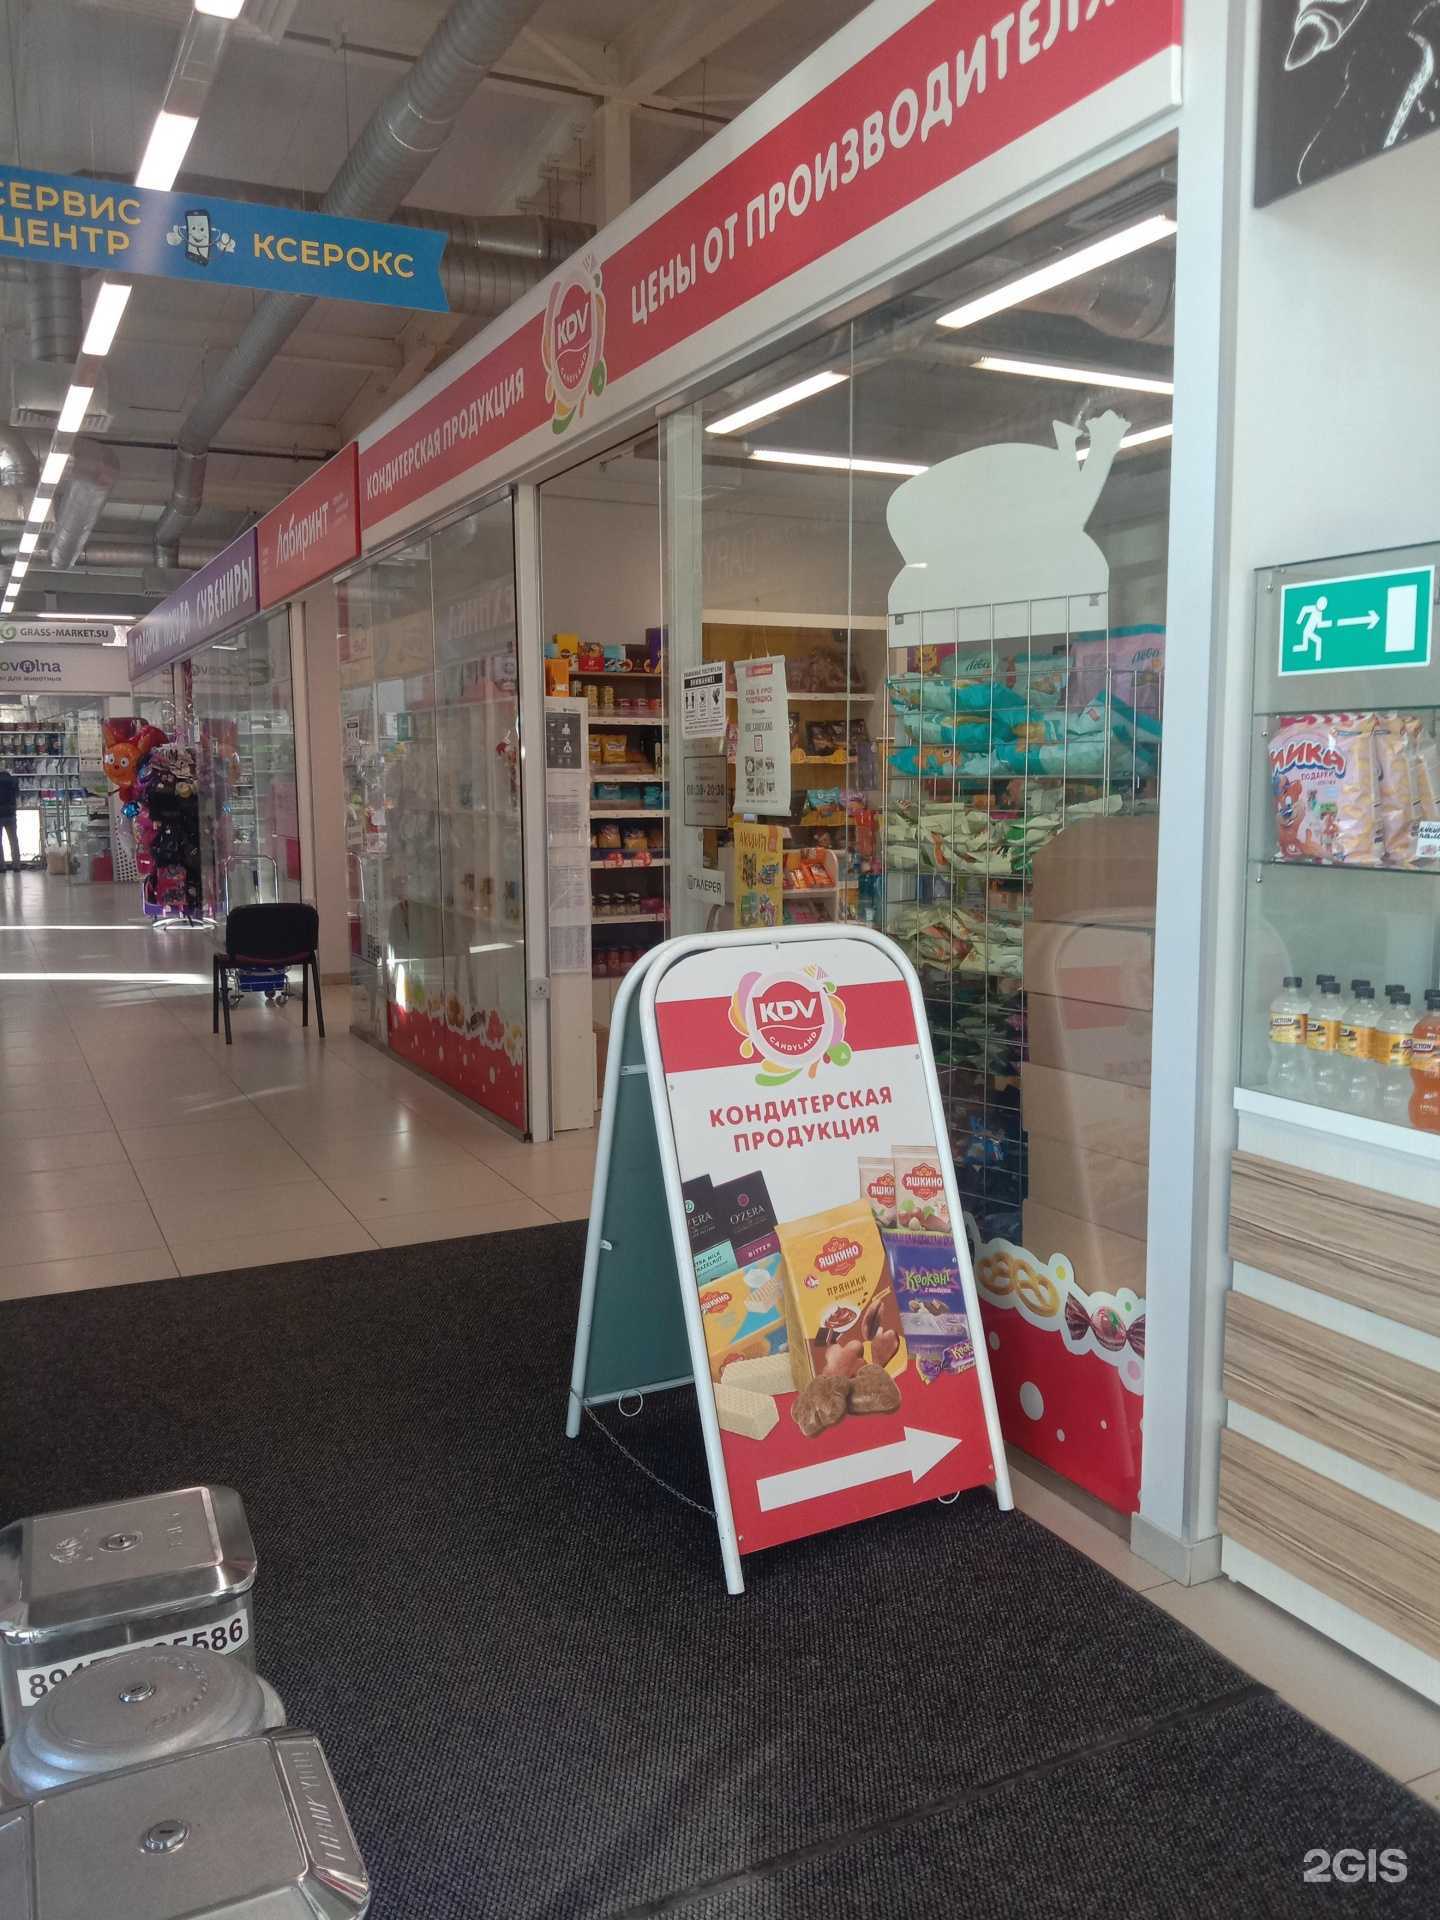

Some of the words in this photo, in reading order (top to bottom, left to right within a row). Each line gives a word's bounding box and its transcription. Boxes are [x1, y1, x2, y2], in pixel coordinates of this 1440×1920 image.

[0, 180, 141, 225] ЕРВИС
[0, 214, 131, 255] ЦЕНТР
[253, 233, 415, 279] КСЕРОКС
[631, 243, 697, 325] ЦЕНЫ
[703, 212, 739, 275] ОТ
[556, 301, 590, 350] KDV
[365, 432, 442, 501] КОНДИТЕРСКАЯ
[442, 367, 525, 451] ПРОДУКЦИЯ
[196, 556, 254, 631] СУВЕНИРЫ
[19, 627, 109, 639] GRASS-MARKET.SU
[758, 997, 818, 1024] KDV
[769, 1031, 819, 1051] CANDYLAND
[709, 1086, 893, 1128] КОНДИТЕРСКАЯ
[733, 1114, 881, 1153] ПРОДУКЦИЯ
[871, 1186, 895, 1195] ЯШКИ
[905, 1176, 943, 1187] ЯШКИНО
[818, 1244, 860, 1269] ЯШКИНО
[826, 1274, 867, 1297] ПРЯНИКИ
